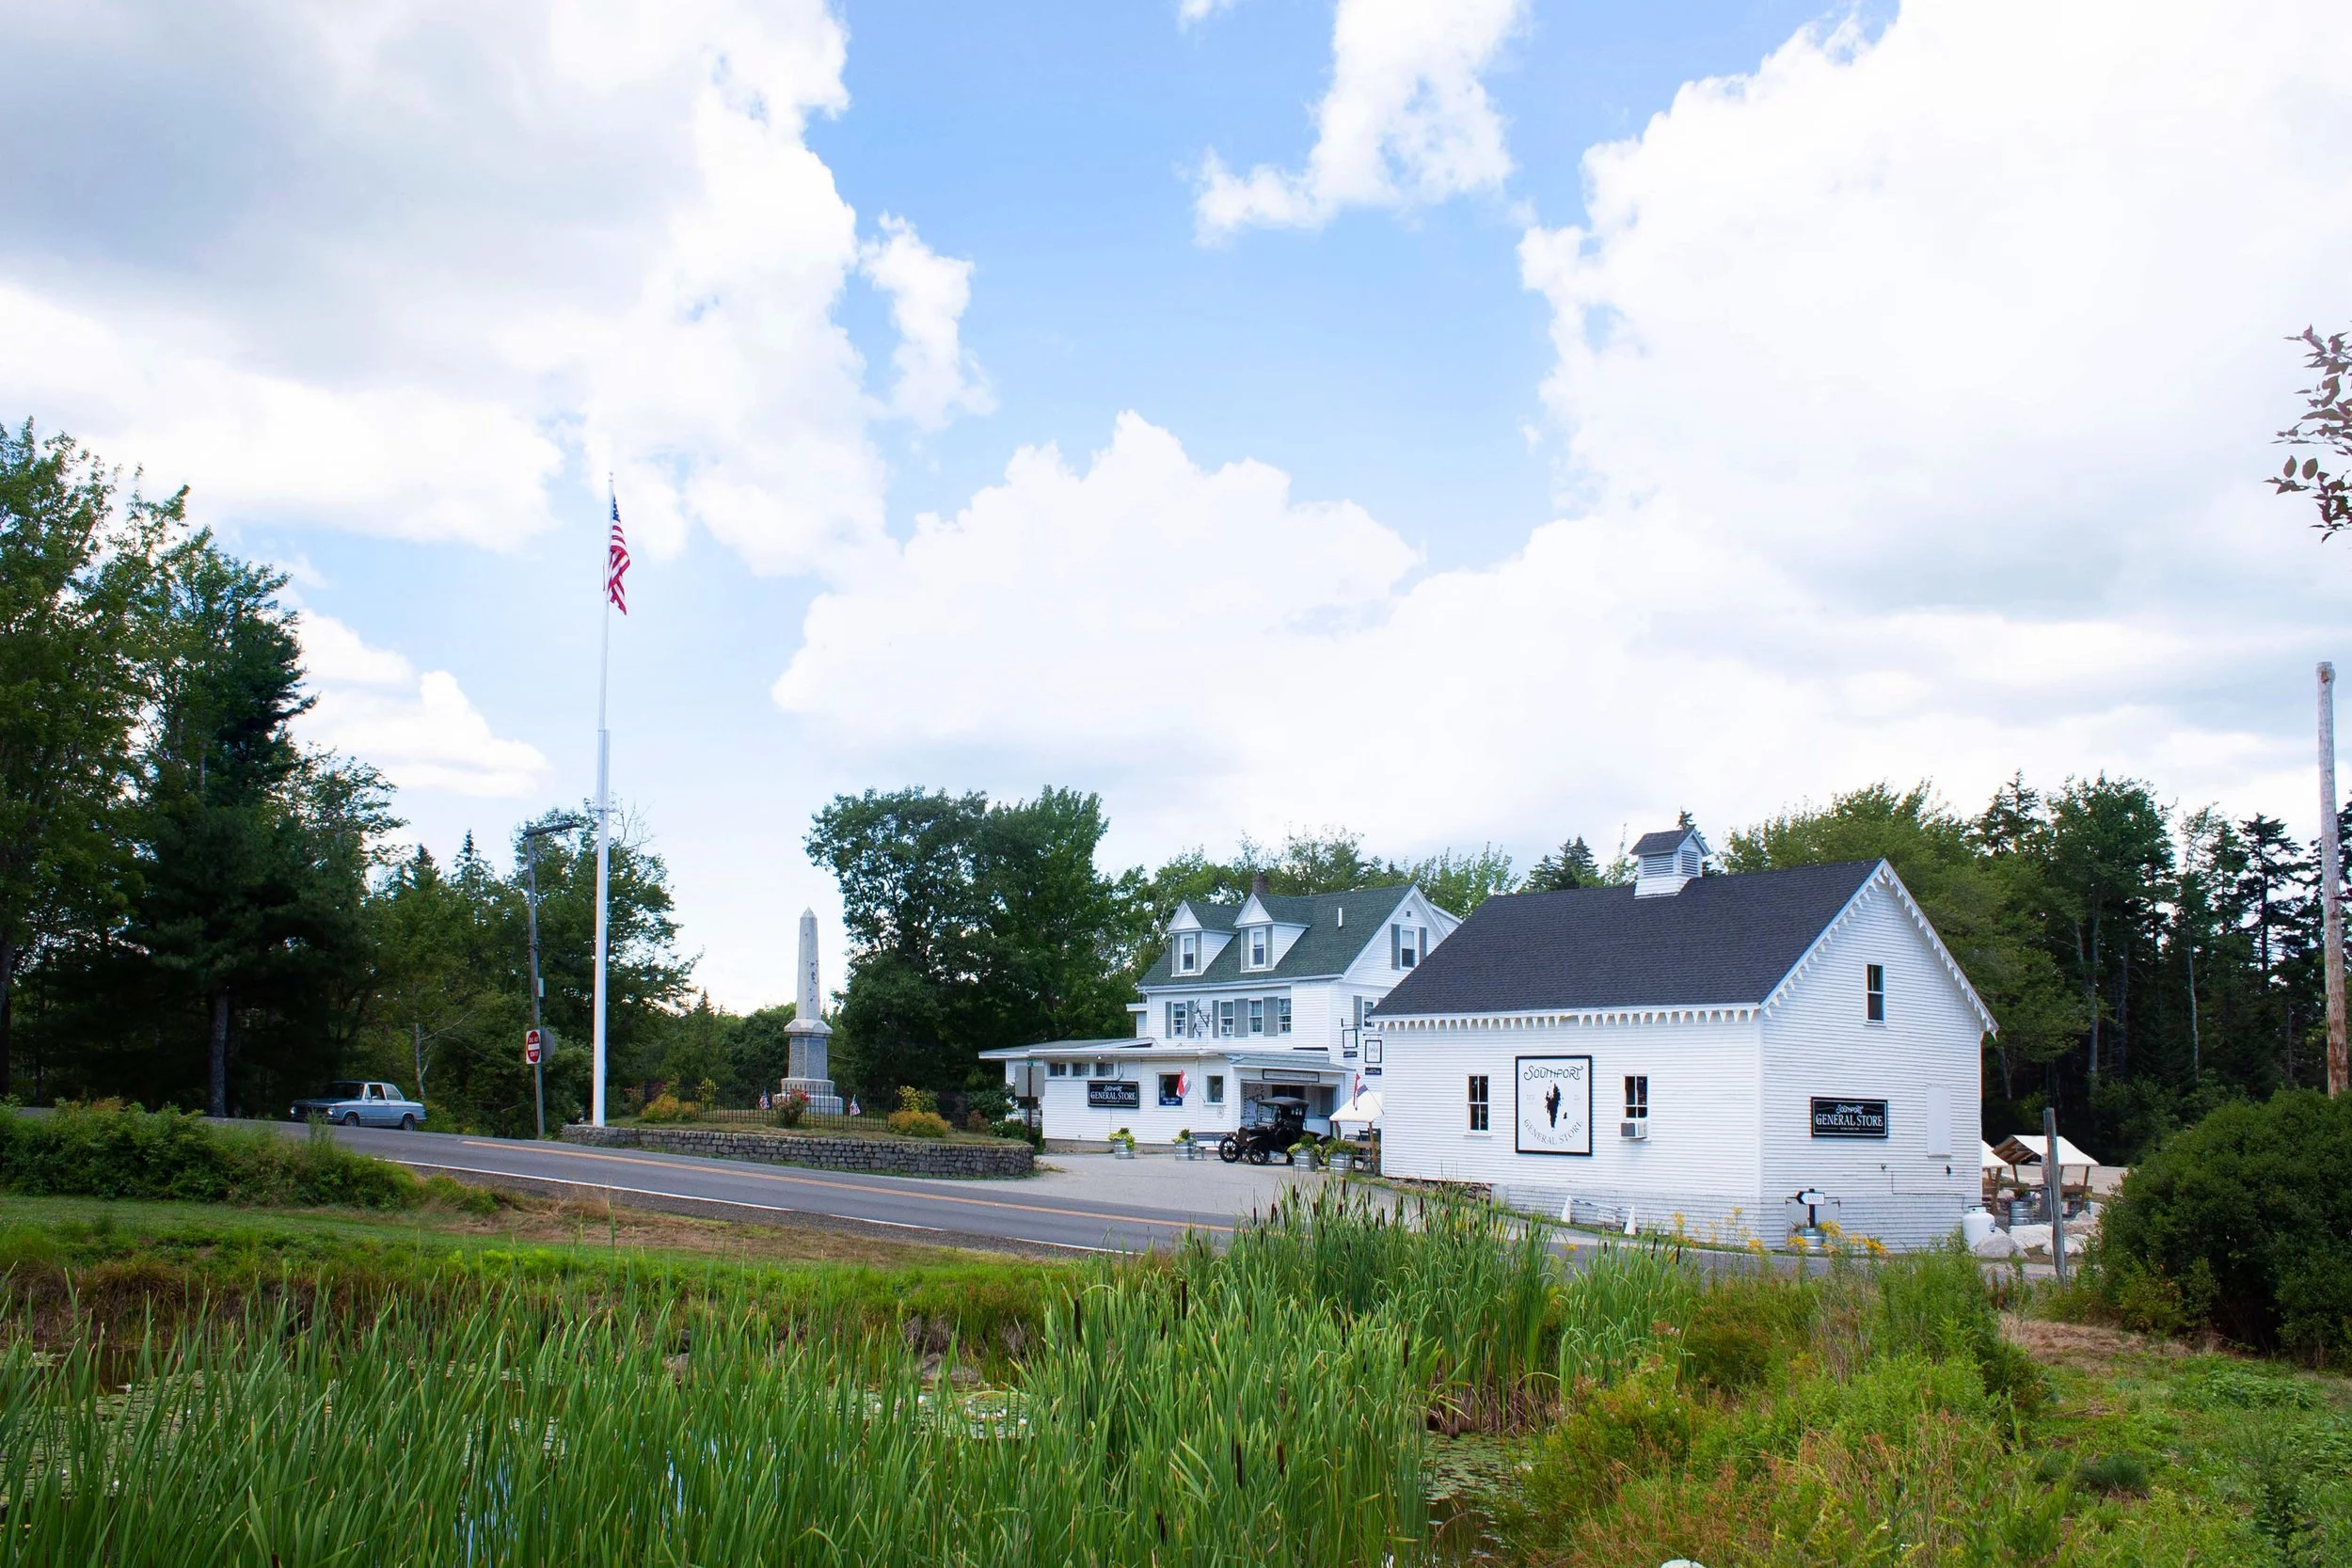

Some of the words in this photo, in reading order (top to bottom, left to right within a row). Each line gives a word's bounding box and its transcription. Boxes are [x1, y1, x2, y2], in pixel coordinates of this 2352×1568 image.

[1089, 1091, 1118, 1100] GENERAL
[1118, 1091, 1136, 1101] STORE
[1816, 1114, 1856, 1126] GENERAL
[1856, 1115, 1883, 1127] STORE
[1523, 1118, 1557, 1146] GENERAL
[1559, 1120, 1583, 1144] STORE
